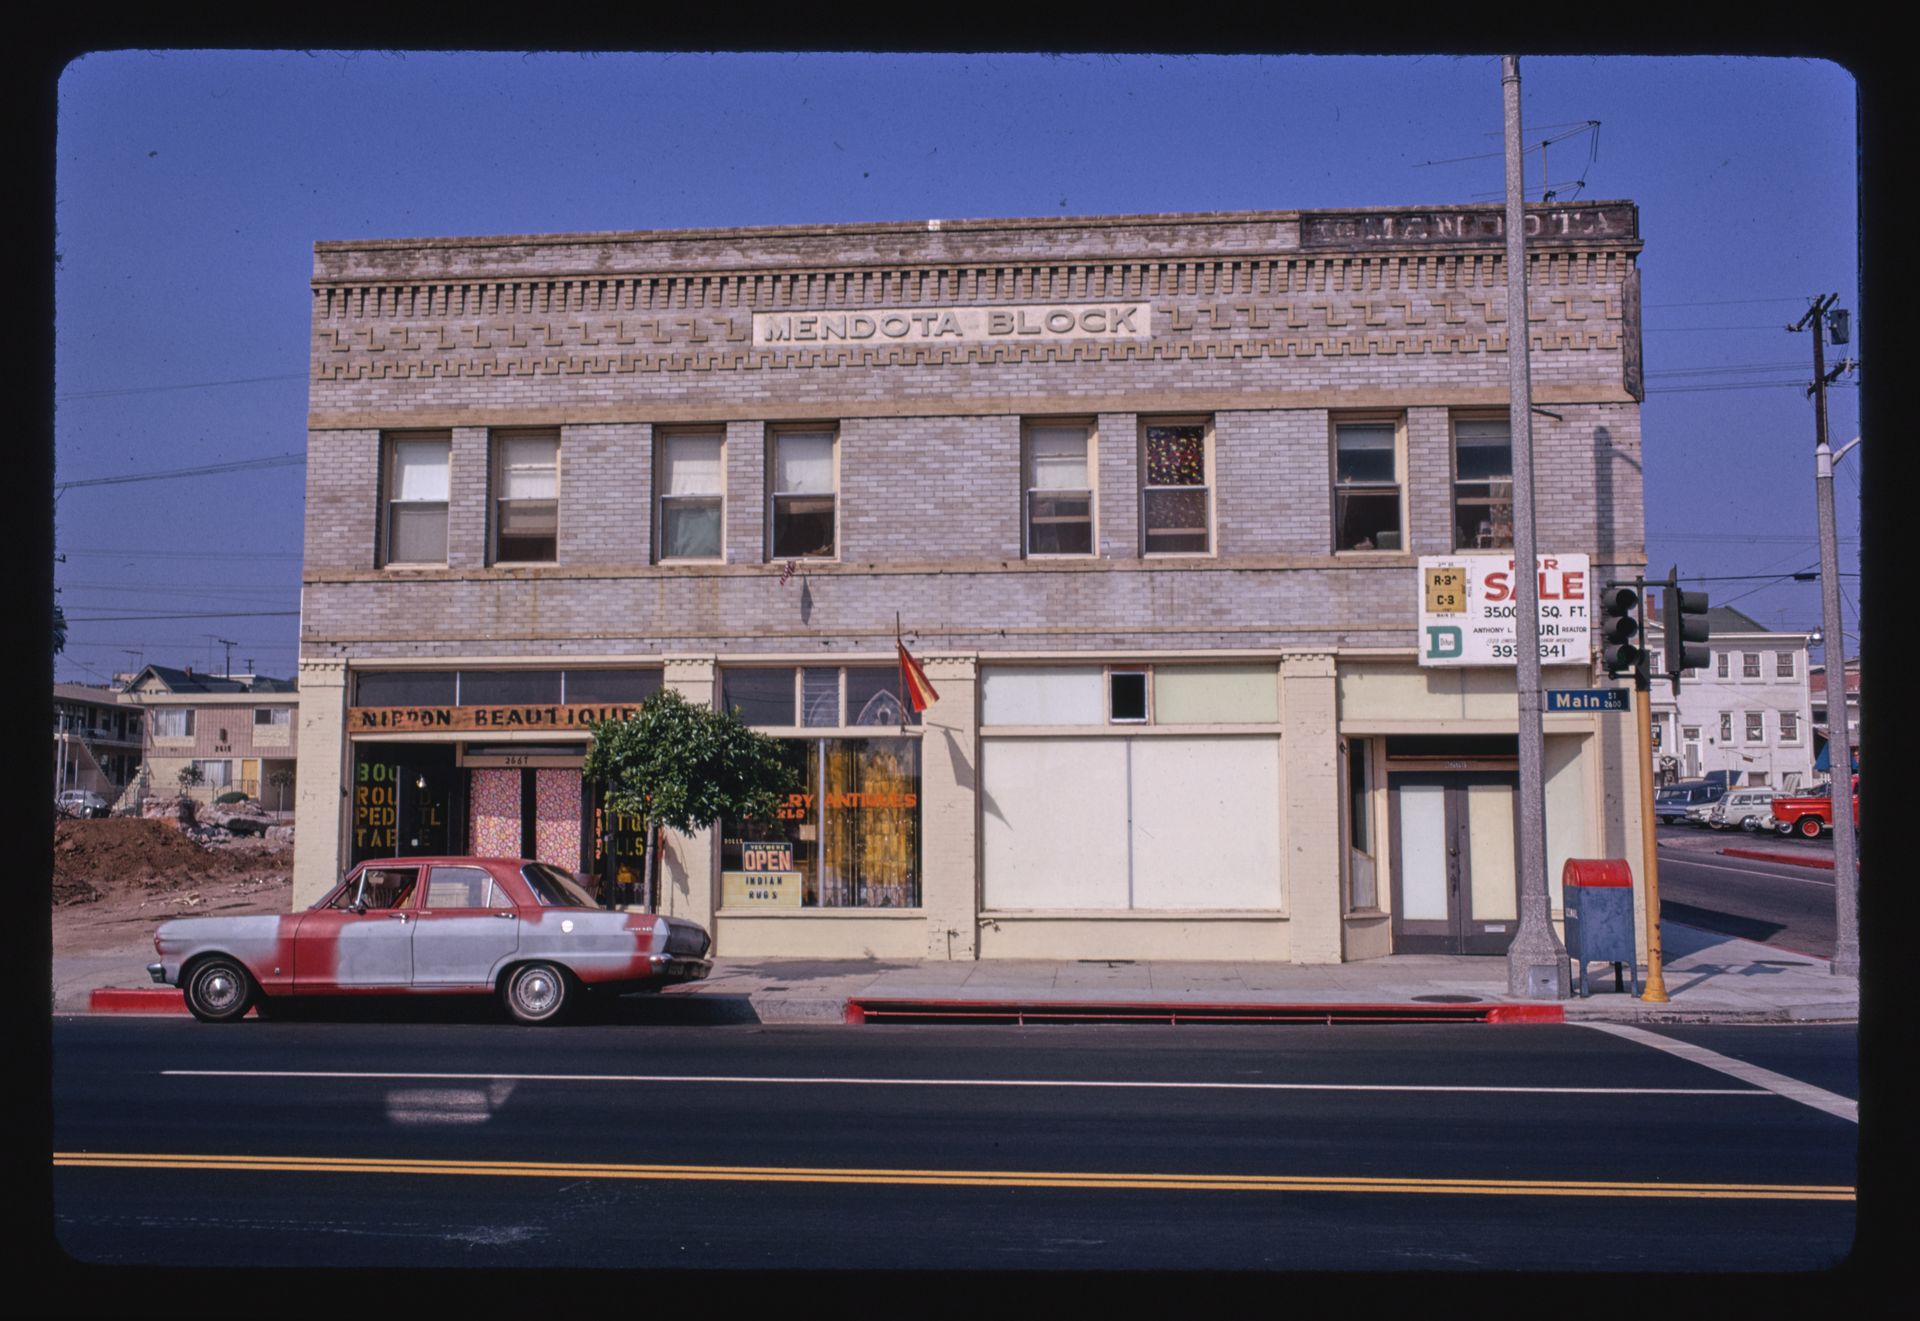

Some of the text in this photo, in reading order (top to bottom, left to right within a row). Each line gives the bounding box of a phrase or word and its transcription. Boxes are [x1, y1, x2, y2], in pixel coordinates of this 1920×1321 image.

[764, 307, 1138, 341] MENDOTA BLOCK
[1508, 559, 1559, 571] FR
[1484, 572, 1585, 601] SLE
[1541, 606, 1563, 619] SQ.
[1569, 606, 1588, 618] FT.
[1556, 693, 1600, 708] Main
[744, 850, 791, 871] OPEN
[746, 876, 783, 885] INDIAN
[749, 890, 778, 899] RUGS
